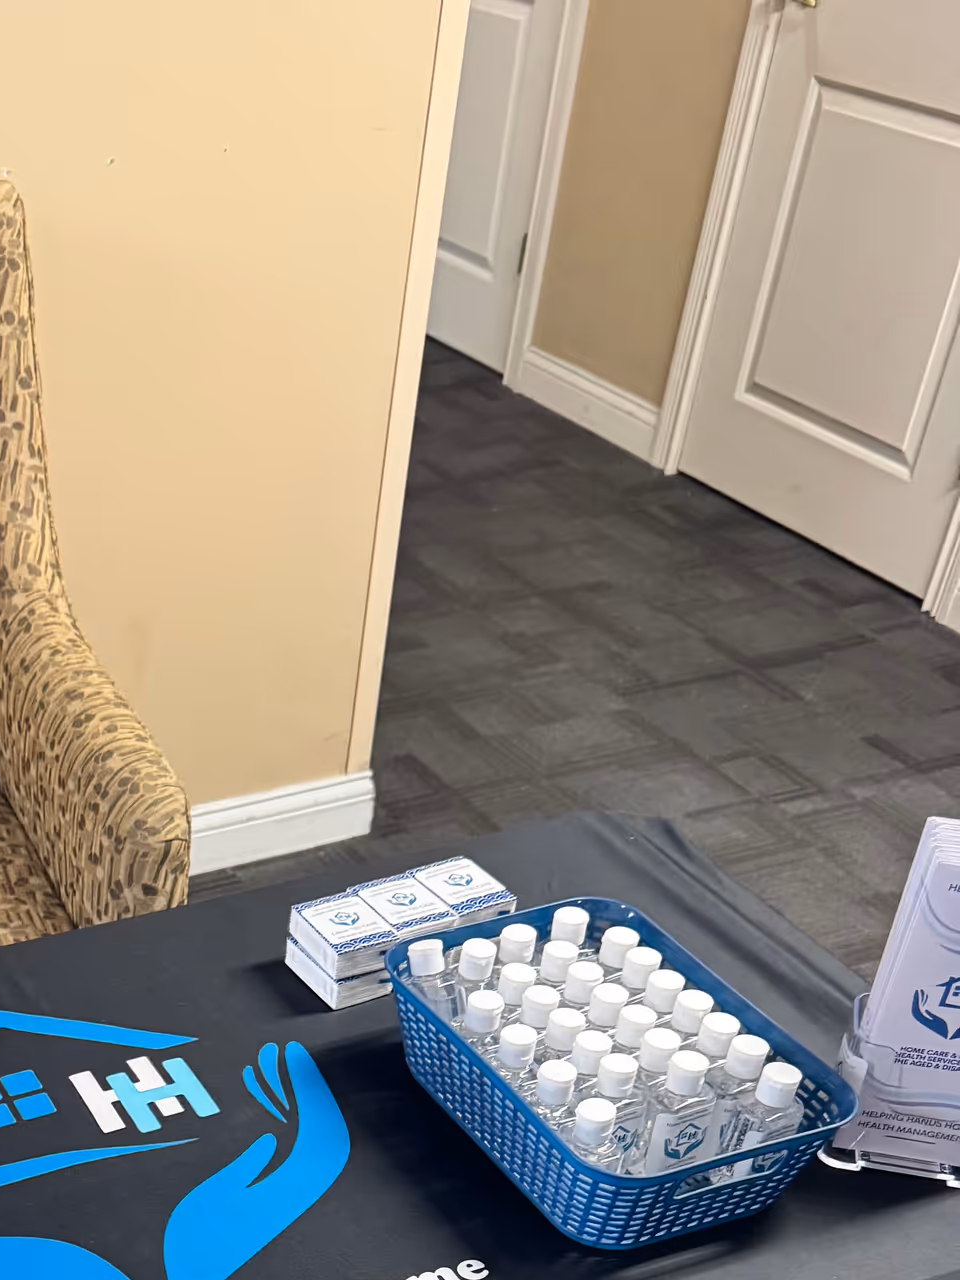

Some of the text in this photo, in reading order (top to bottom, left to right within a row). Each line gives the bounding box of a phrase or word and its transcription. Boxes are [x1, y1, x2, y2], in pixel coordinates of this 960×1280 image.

[900, 1046, 926, 1055] HOME
[926, 1050, 950, 1058] CARE
[862, 1110, 905, 1122] HELPING
[906, 1115, 942, 1128] HANDS
[858, 1121, 895, 1131] HEALTH
